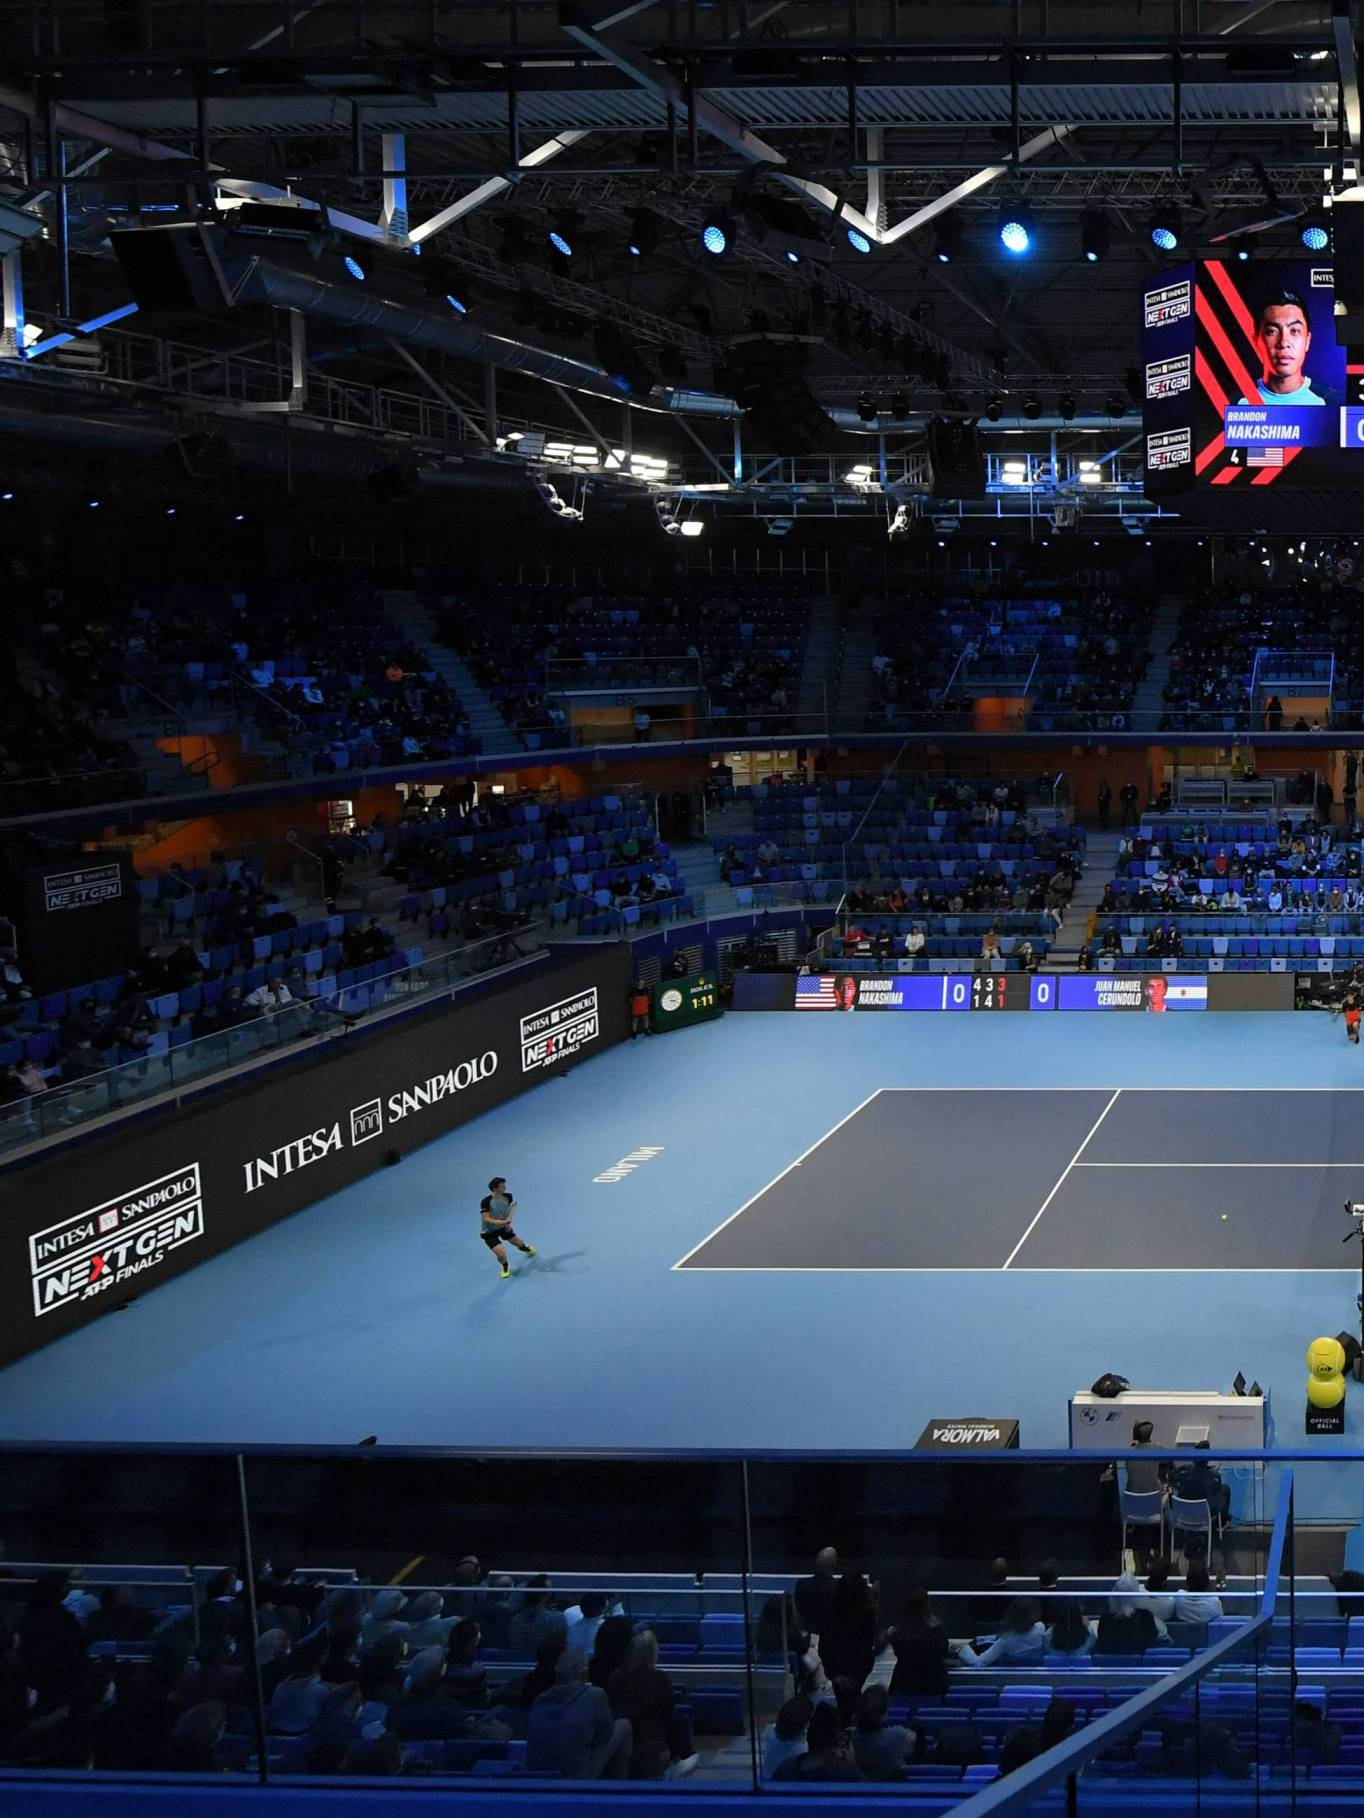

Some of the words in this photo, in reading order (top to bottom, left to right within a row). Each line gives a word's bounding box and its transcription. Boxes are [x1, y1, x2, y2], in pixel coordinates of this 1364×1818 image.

[1313, 274, 1334, 282] INTES
[1148, 308, 1170, 323] NEXT
[1170, 303, 1187, 316] GEN
[1149, 380, 1170, 394] NEXT
[1171, 376, 1187, 389] GEN
[1227, 411, 1267, 421] BRANDON
[1227, 425, 1300, 439] NAKASHIMA
[1151, 452, 1171, 465] NEXT
[1171, 449, 1187, 461] GEN
[1230, 449, 1239, 464] 4
[859, 980, 893, 991] BRANDON
[973, 978, 981, 991] 4
[986, 978, 994, 991] 3
[998, 978, 1006, 991] 3
[1094, 980, 1112, 992] JUAN
[1113, 980, 1142, 992] MANUEL
[858, 992, 903, 1005] NAKASHIMA
[953, 983, 965, 1004] 0
[1037, 983, 1049, 1003] 0
[1097, 993, 1142, 1006] CERUNDOLO
[691, 994, 713, 1009] 1:11
[973, 995, 979, 1008] 1
[984, 995, 993, 1008] 4
[998, 995, 1005, 1008] 1
[527, 1031, 567, 1065] NEXT
[567, 1018, 595, 1044] GEN
[558, 1042, 580, 1059] FINALS
[242, 1122, 344, 1193] INTESA
[388, 1050, 498, 1123] SANPAOLO
[592, 1146, 665, 1183] MILANO
[36, 1222, 95, 1259] INTESA
[121, 1176, 195, 1221] SANPAOLO
[44, 1239, 134, 1304] NEXT
[135, 1210, 195, 1256] GEN
[80, 1275, 115, 1301] ATP
[115, 1250, 164, 1283] FINALS
[933, 1428, 1000, 1444] VALMORA
